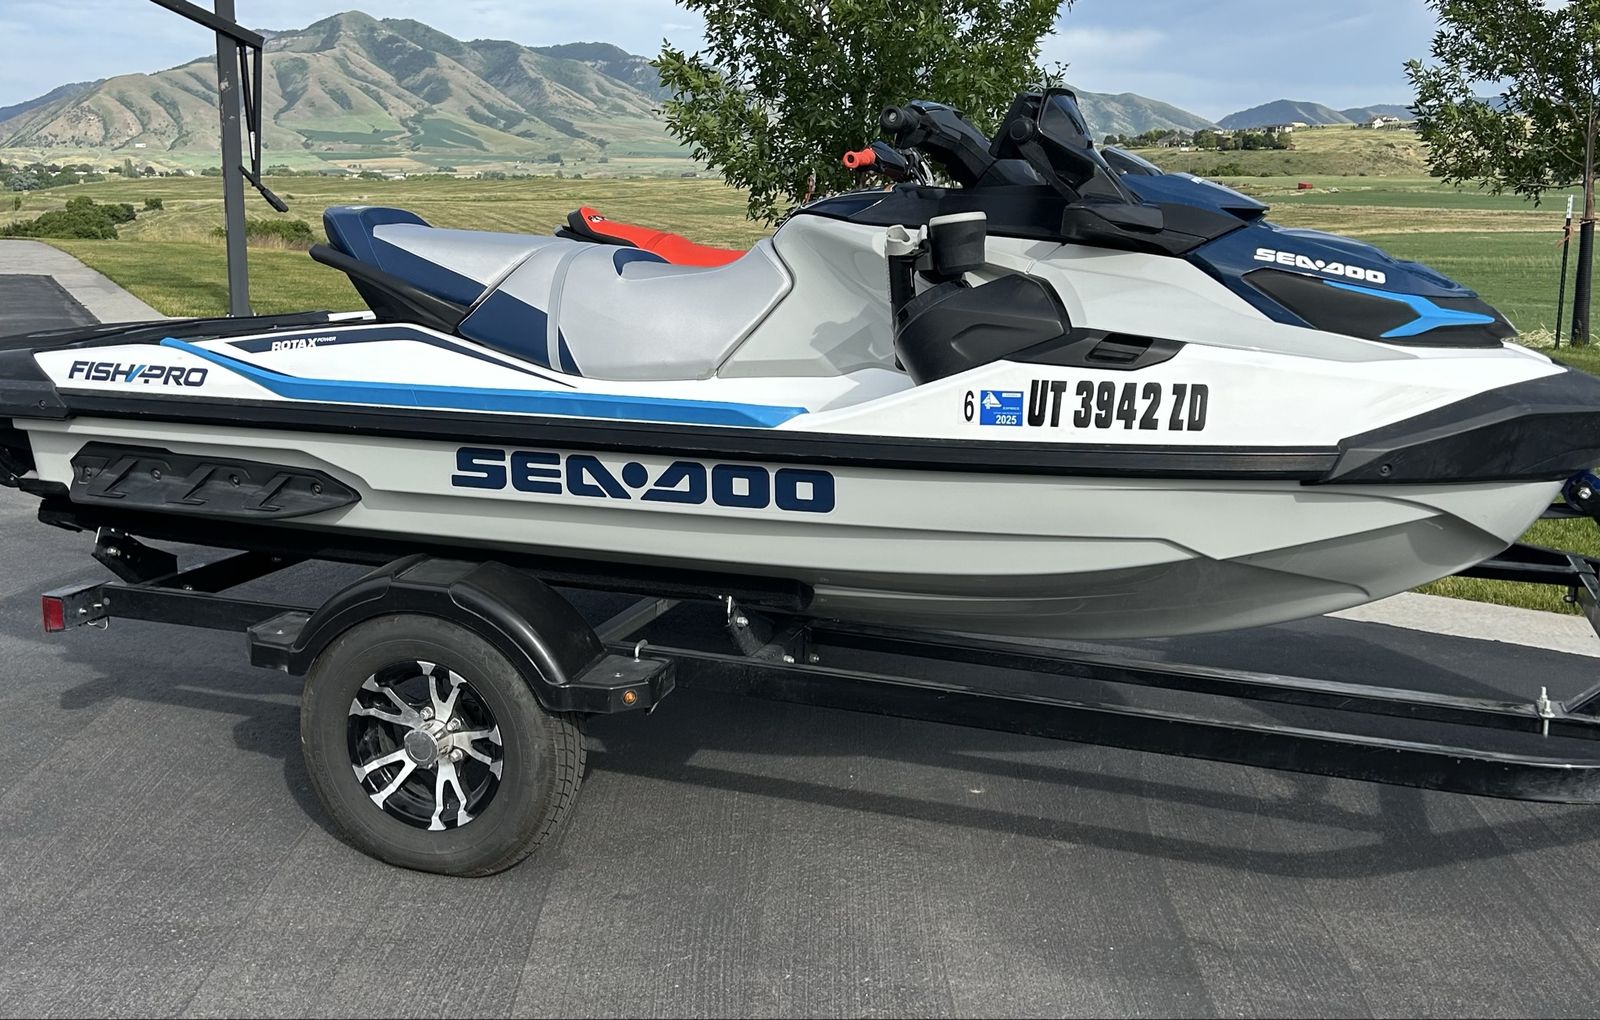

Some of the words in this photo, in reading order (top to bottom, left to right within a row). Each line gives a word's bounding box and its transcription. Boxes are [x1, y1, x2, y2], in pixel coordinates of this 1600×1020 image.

[271, 338, 318, 351] ROTAX
[963, 390, 975, 422] 6
[1027, 379, 1067, 428] UT
[1073, 380, 1162, 431] 3942
[1168, 383, 1209, 432] ZD
[995, 414, 1017, 425] 2025
